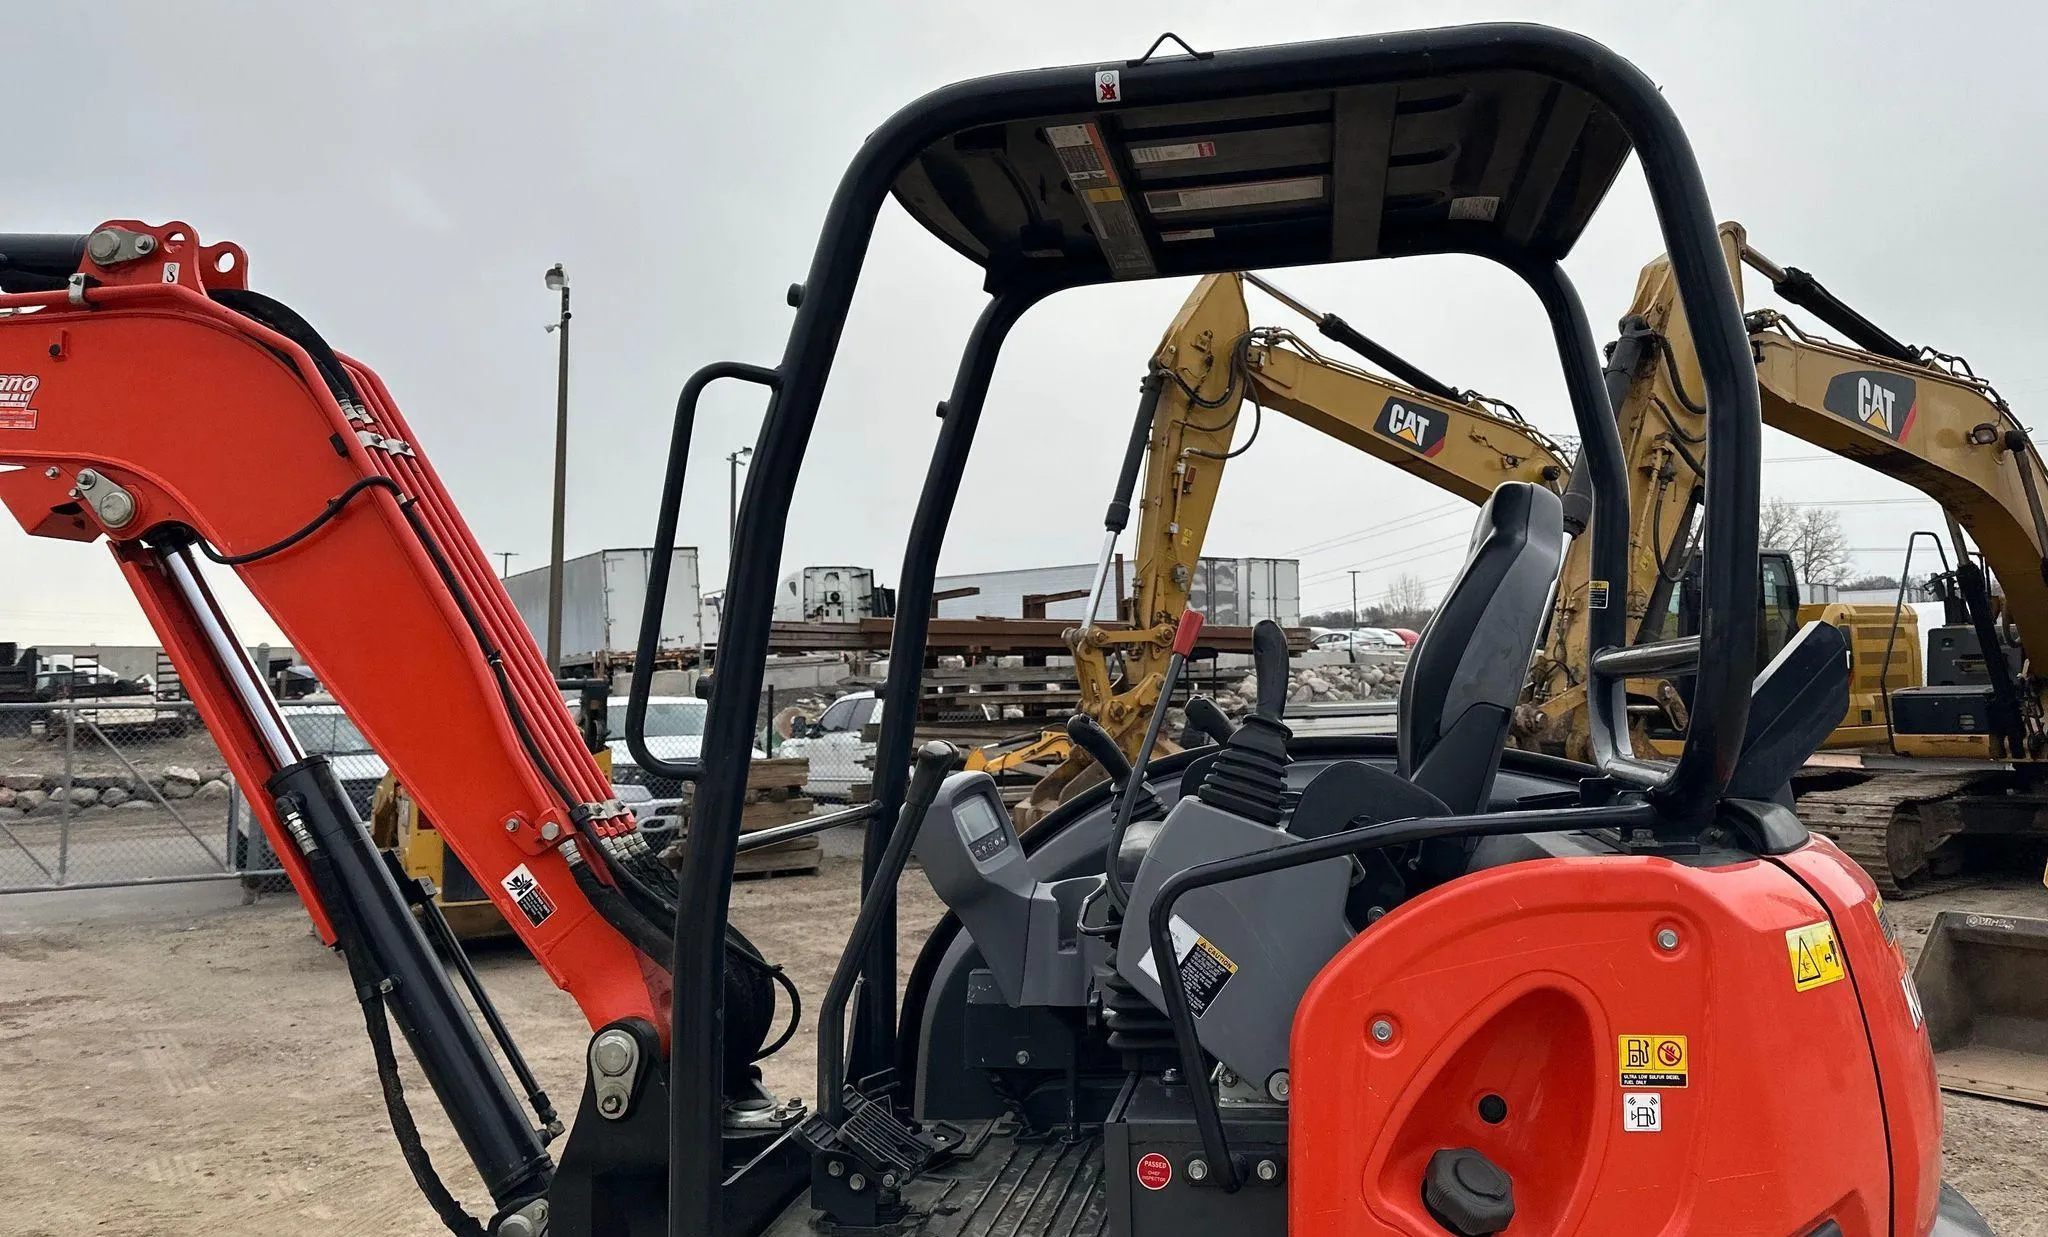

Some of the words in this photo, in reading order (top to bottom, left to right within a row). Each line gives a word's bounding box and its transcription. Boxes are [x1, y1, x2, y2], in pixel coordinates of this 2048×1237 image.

[1858, 377, 1896, 434] CAT
[1388, 403, 1430, 447] CAT
[1207, 945, 1233, 969] CAUTION
[1144, 1160, 1167, 1169] PASSED
